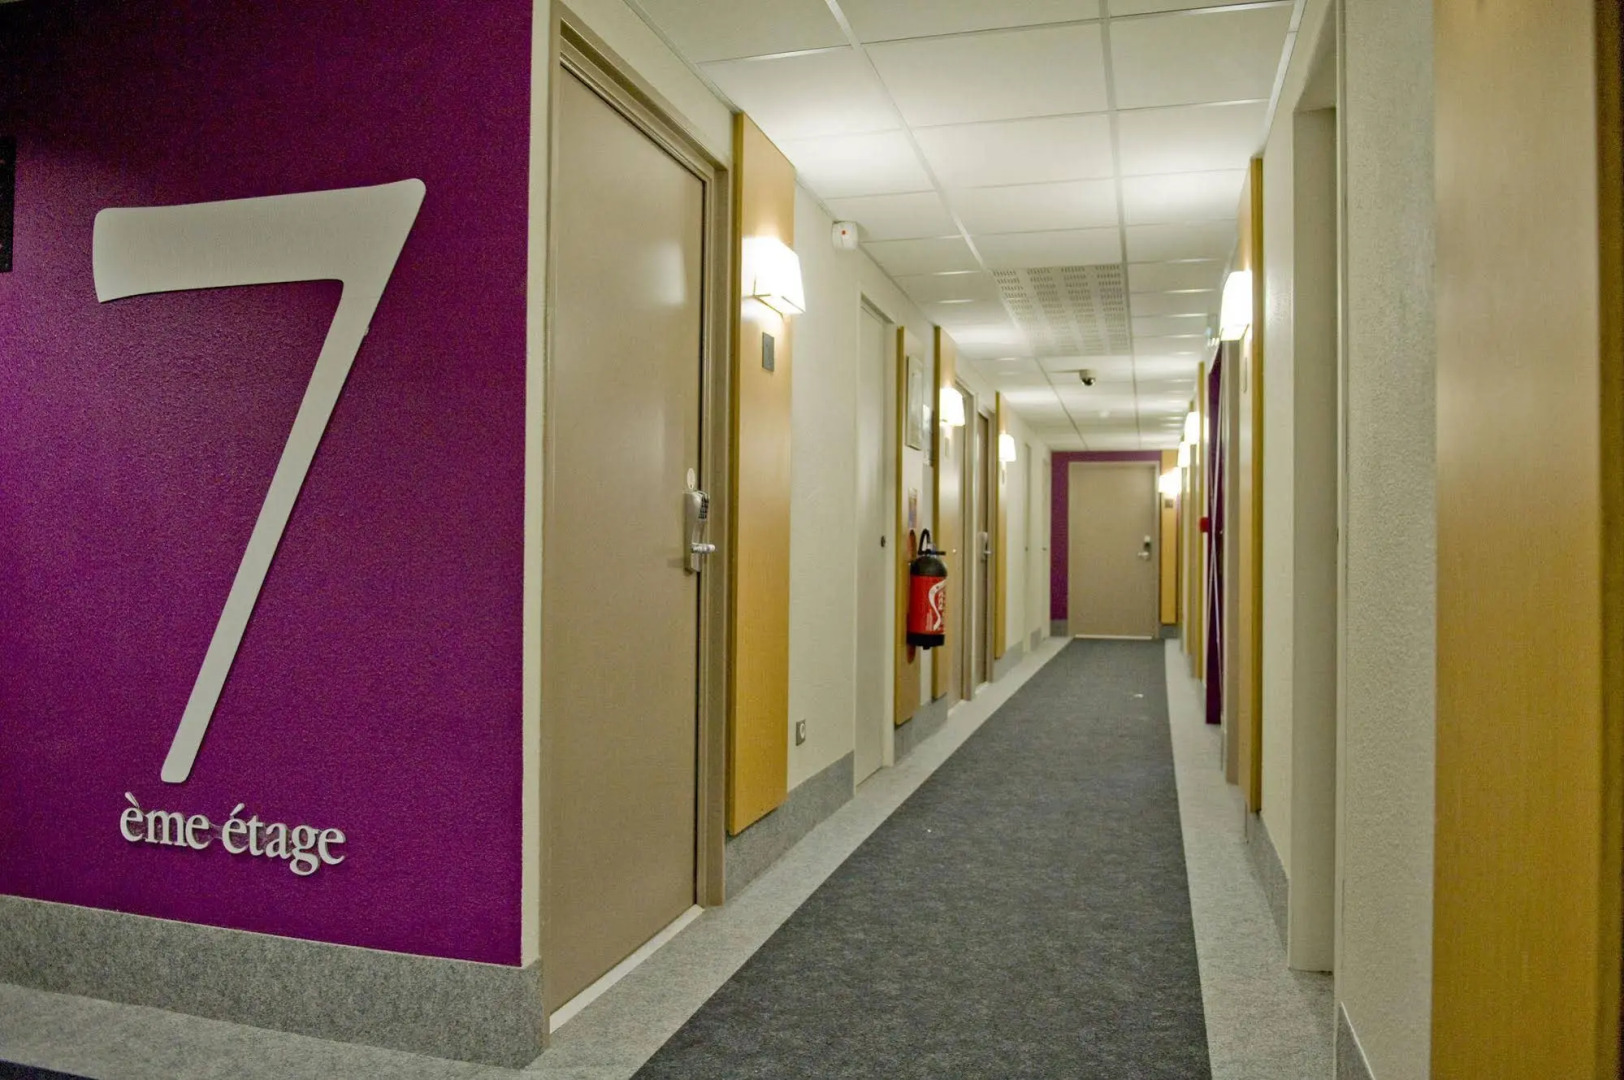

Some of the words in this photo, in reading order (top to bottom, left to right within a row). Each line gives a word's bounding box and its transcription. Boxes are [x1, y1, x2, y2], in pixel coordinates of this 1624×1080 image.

[92, 178, 426, 783] 7
[120, 792, 210, 850] ème
[222, 803, 346, 876] étage
